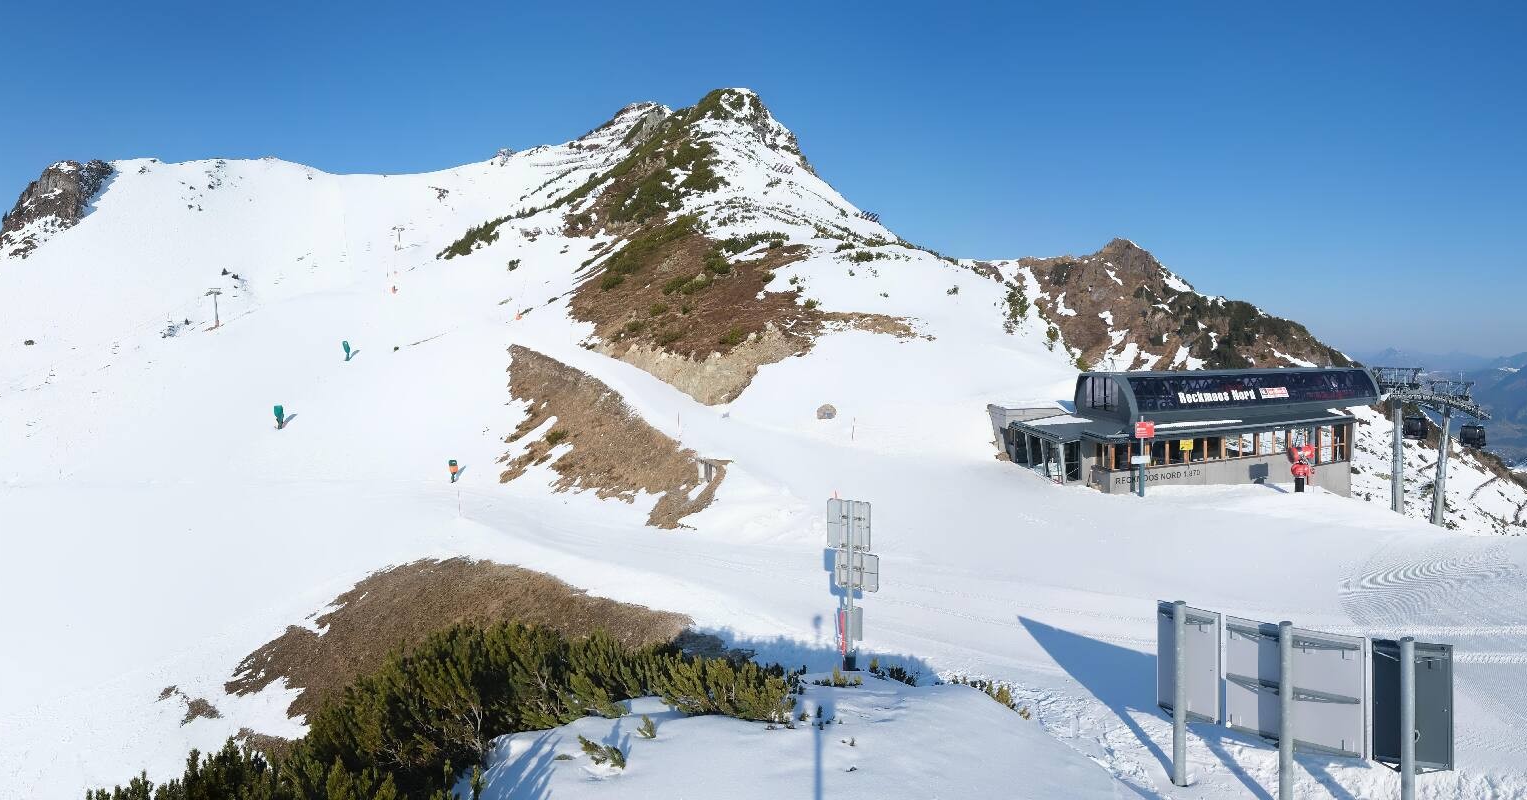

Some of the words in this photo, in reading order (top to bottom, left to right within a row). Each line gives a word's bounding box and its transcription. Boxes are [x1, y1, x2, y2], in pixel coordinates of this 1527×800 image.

[1178, 391, 1230, 403] Reckmoos
[1231, 389, 1256, 401] Nord
[1160, 471, 1182, 481] NORD
